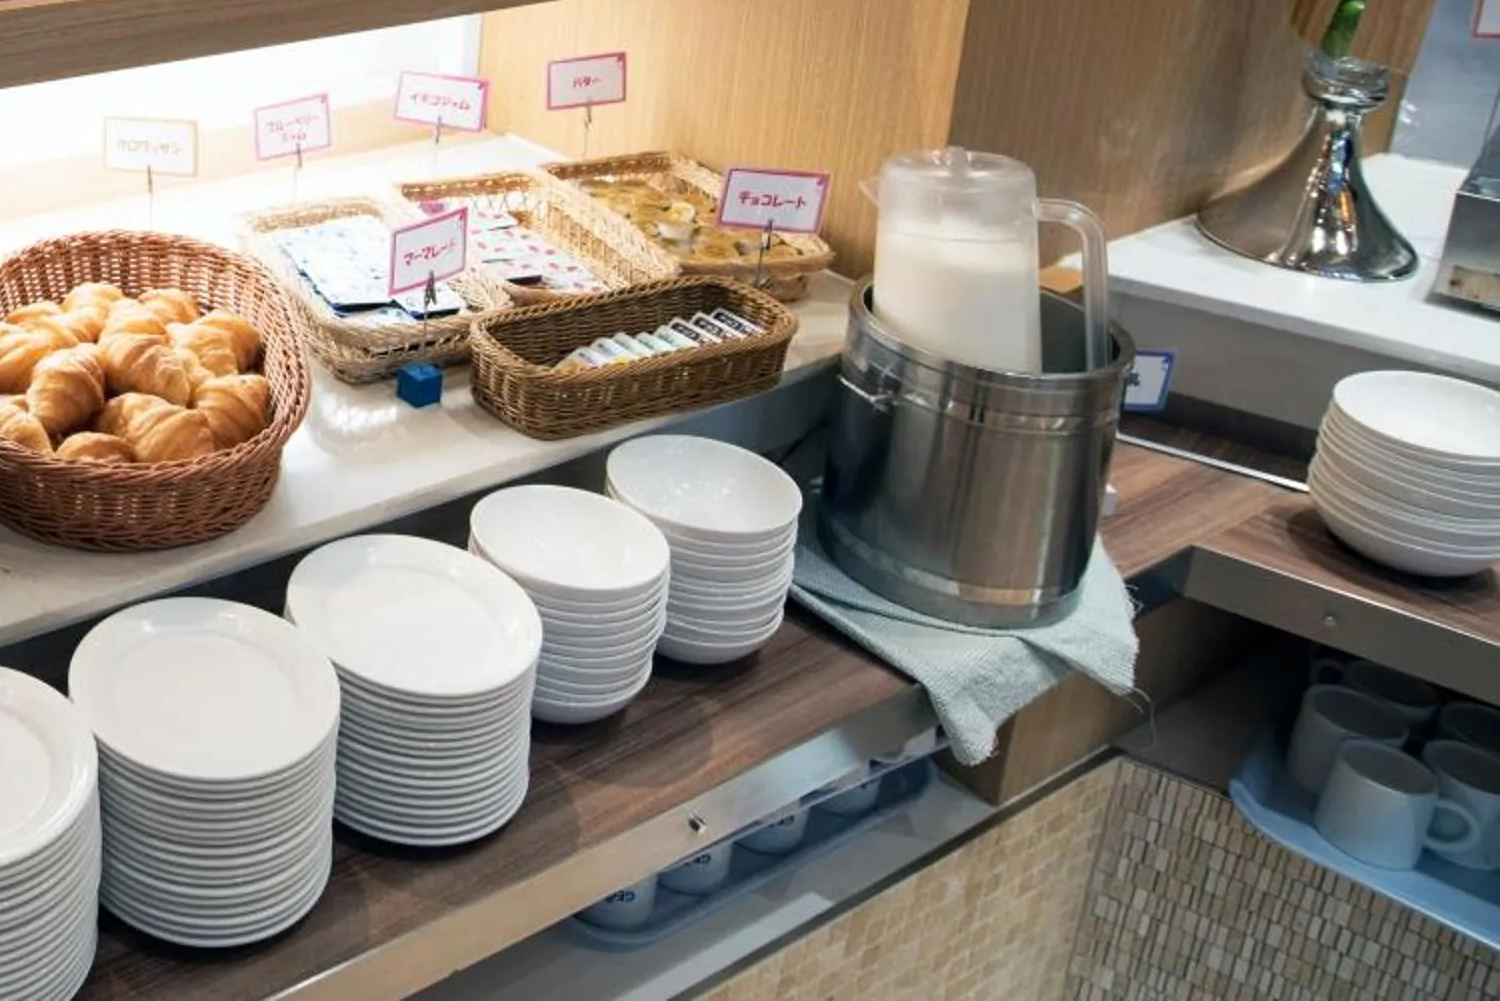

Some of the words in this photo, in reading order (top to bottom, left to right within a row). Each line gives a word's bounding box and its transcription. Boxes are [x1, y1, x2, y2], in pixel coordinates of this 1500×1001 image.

[738, 189, 806, 209] チョコレート
